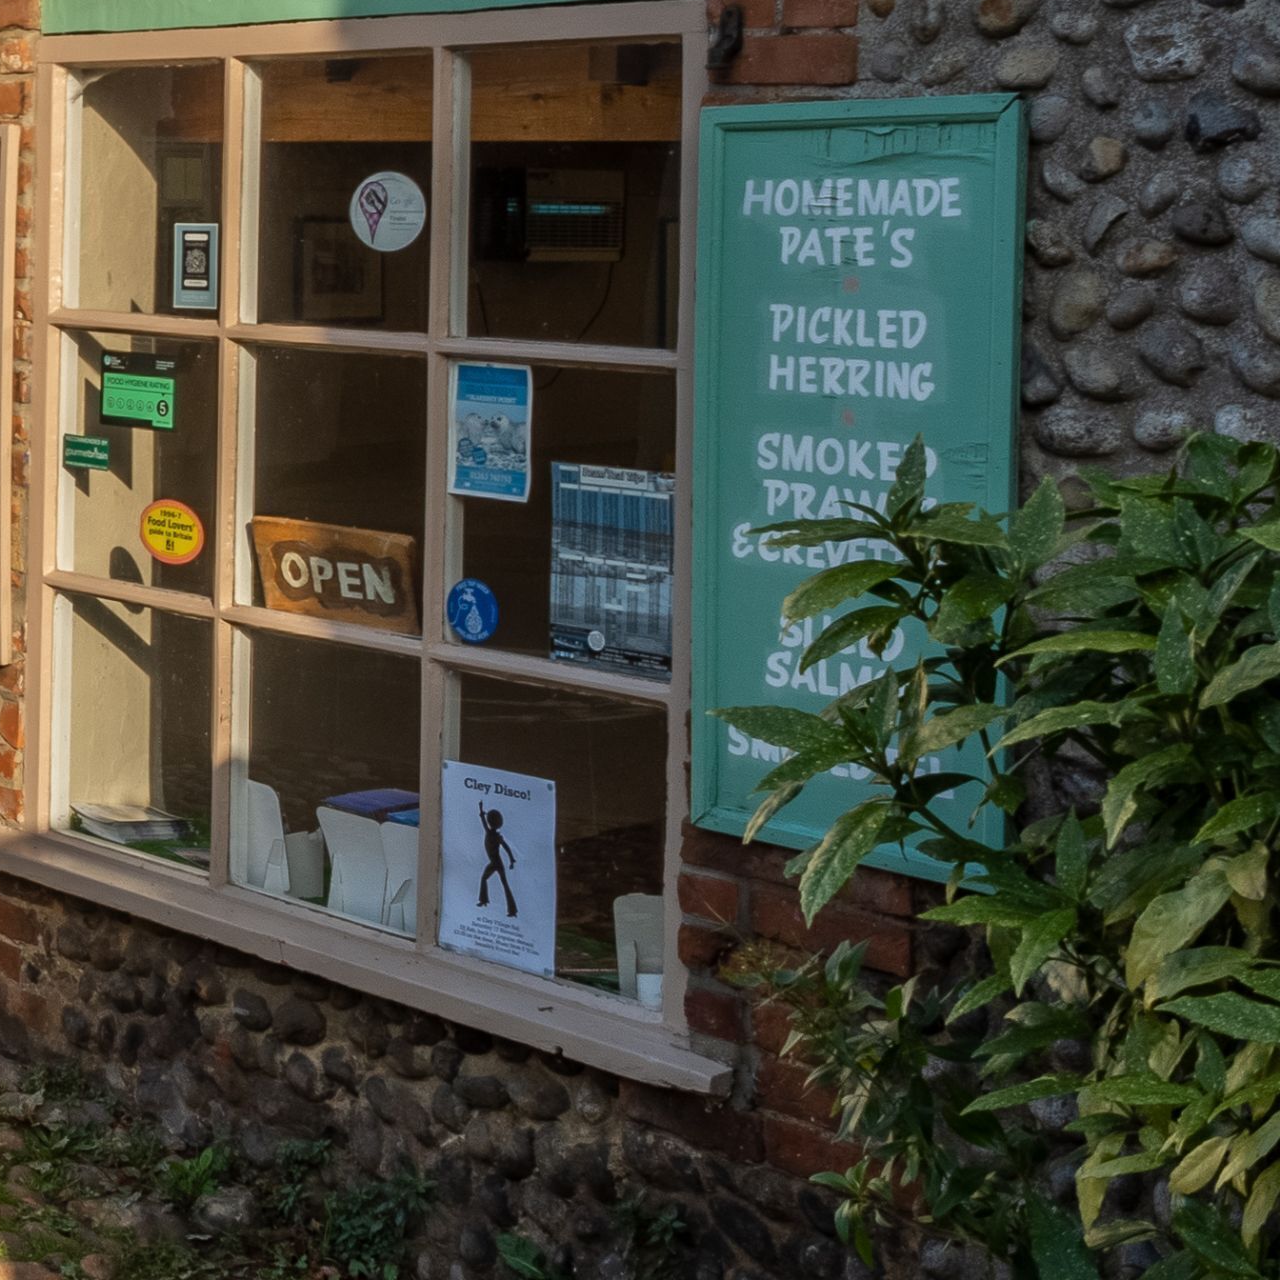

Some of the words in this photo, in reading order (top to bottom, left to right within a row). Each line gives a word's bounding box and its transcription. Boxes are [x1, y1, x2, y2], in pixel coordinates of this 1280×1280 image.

[743, 177, 962, 218] HOMEMADE
[779, 220, 916, 269] PATE'S
[769, 303, 928, 350] PICKLED
[768, 354, 936, 402] HERRING
[159, 402, 167, 415] 5
[148, 516, 166, 527] Food
[763, 479, 938, 521] PRAW
[281, 552, 395, 604] OPEN
[765, 650, 906, 697] SALM
[464, 777, 491, 795] Cley
[494, 783, 531, 801] Disco!
